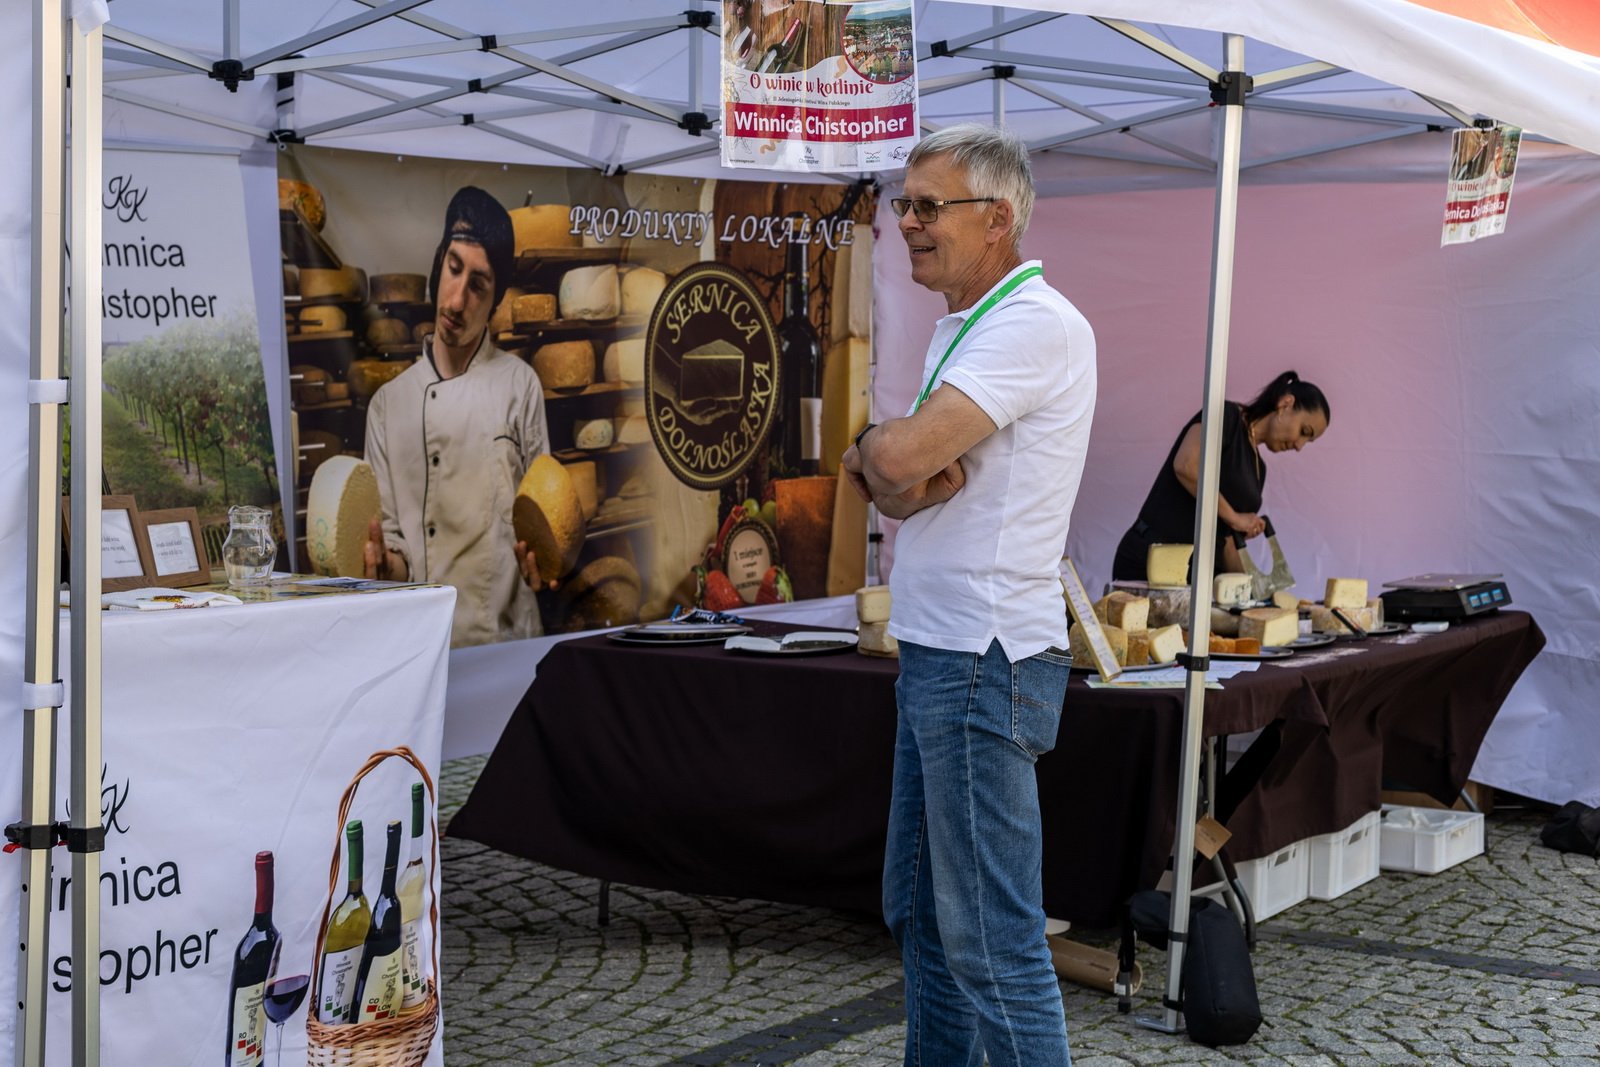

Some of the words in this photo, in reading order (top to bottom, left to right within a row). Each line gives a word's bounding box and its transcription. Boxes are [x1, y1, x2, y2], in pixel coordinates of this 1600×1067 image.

[750, 73, 761, 89] O
[766, 76, 802, 97] winie
[806, 81, 816, 93] w
[817, 78, 873, 97] kotlinie
[734, 110, 802, 133] Winnica
[805, 115, 907, 138] Chistopher
[569, 205, 713, 247] PRODUKTY
[719, 213, 856, 250] LOKALNE
[665, 283, 762, 344] SERNICA
